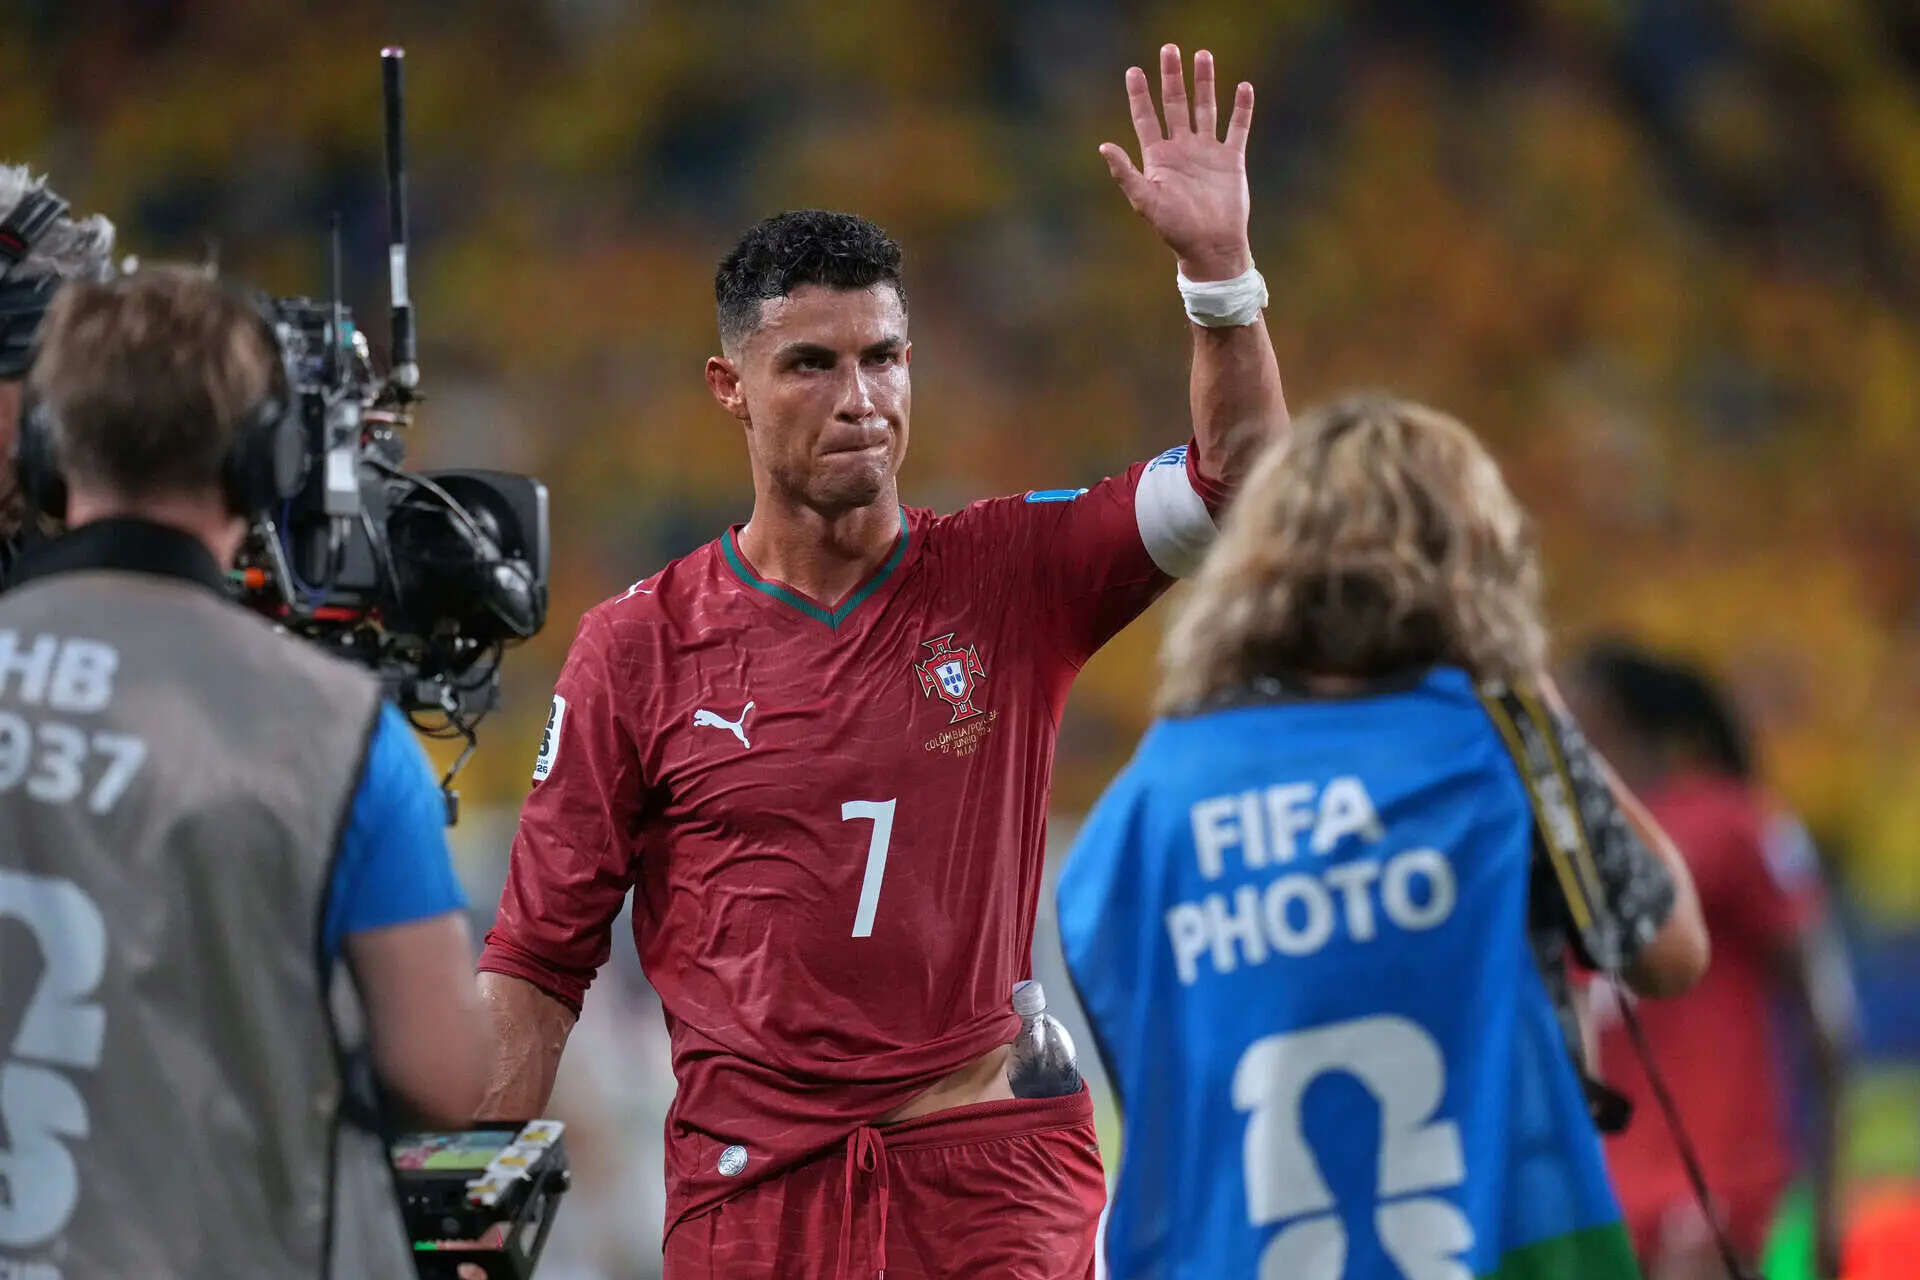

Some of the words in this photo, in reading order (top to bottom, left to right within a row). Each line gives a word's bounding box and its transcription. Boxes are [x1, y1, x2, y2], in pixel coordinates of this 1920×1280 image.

[0, 629, 119, 714] HB
[537, 764, 548, 774] 26
[952, 734, 977, 750] JUNHO
[956, 744, 977, 758] MIA
[841, 798, 897, 937] 7
[1190, 775, 1385, 880] FIFA
[1166, 848, 1457, 986] PHOTO
